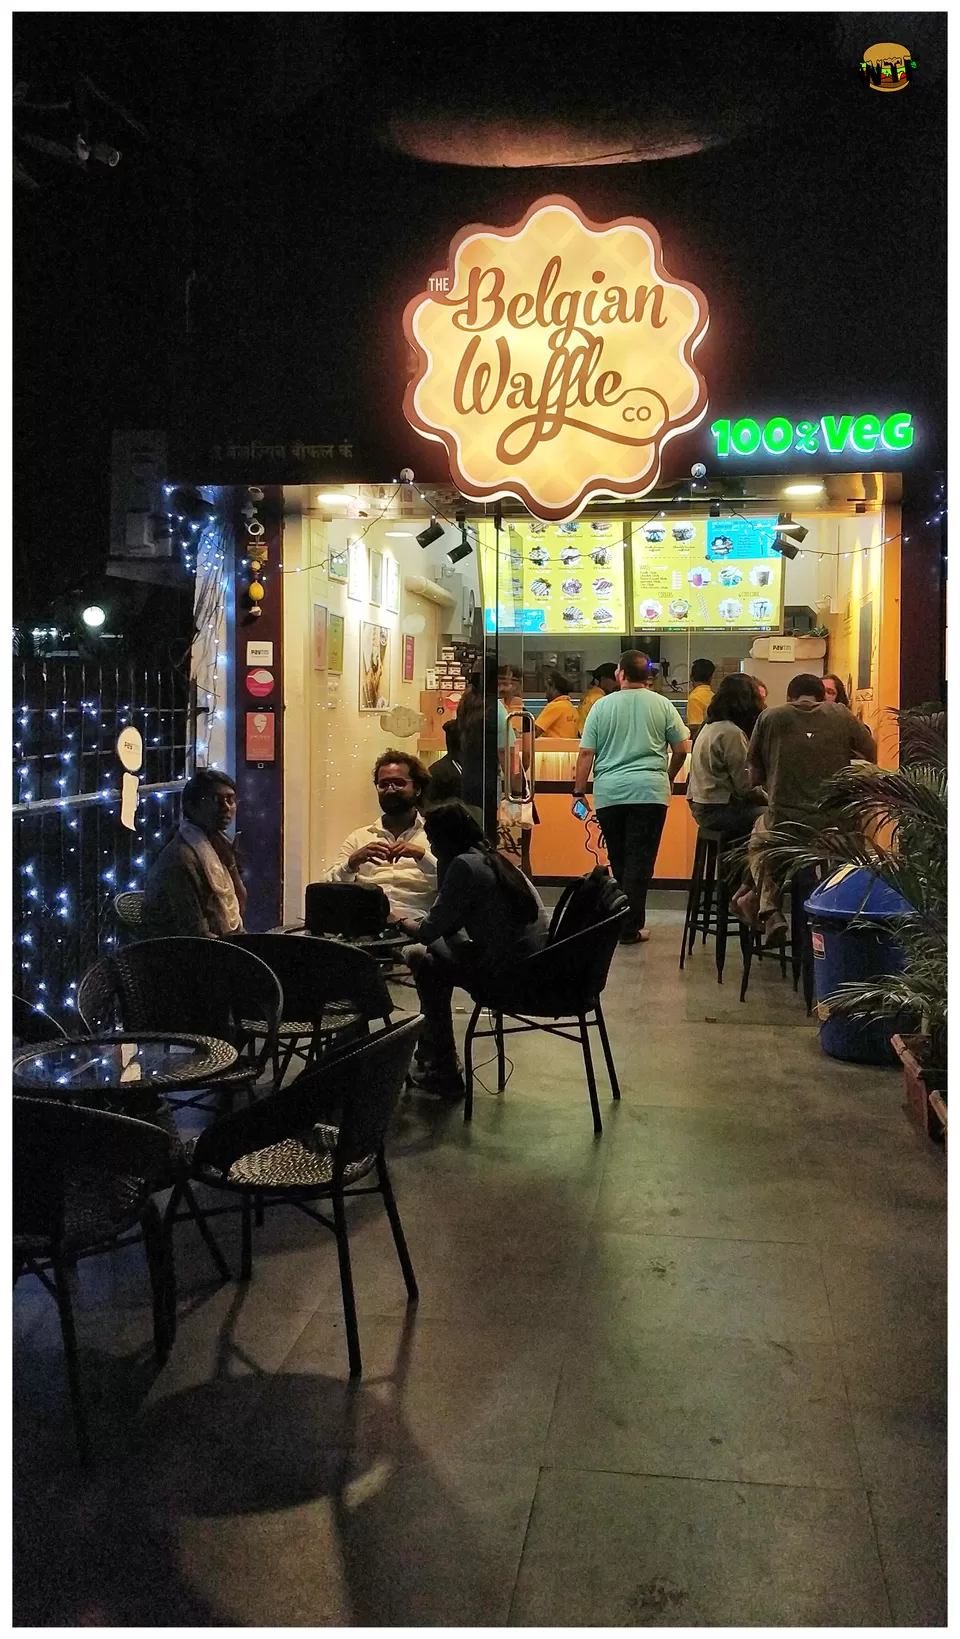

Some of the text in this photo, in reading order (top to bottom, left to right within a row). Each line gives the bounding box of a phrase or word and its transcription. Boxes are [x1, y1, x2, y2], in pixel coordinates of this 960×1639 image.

[428, 277, 450, 292] THE
[451, 256, 668, 352] Belgian
[453, 335, 642, 464] Waffle
[622, 405, 652, 422] CO
